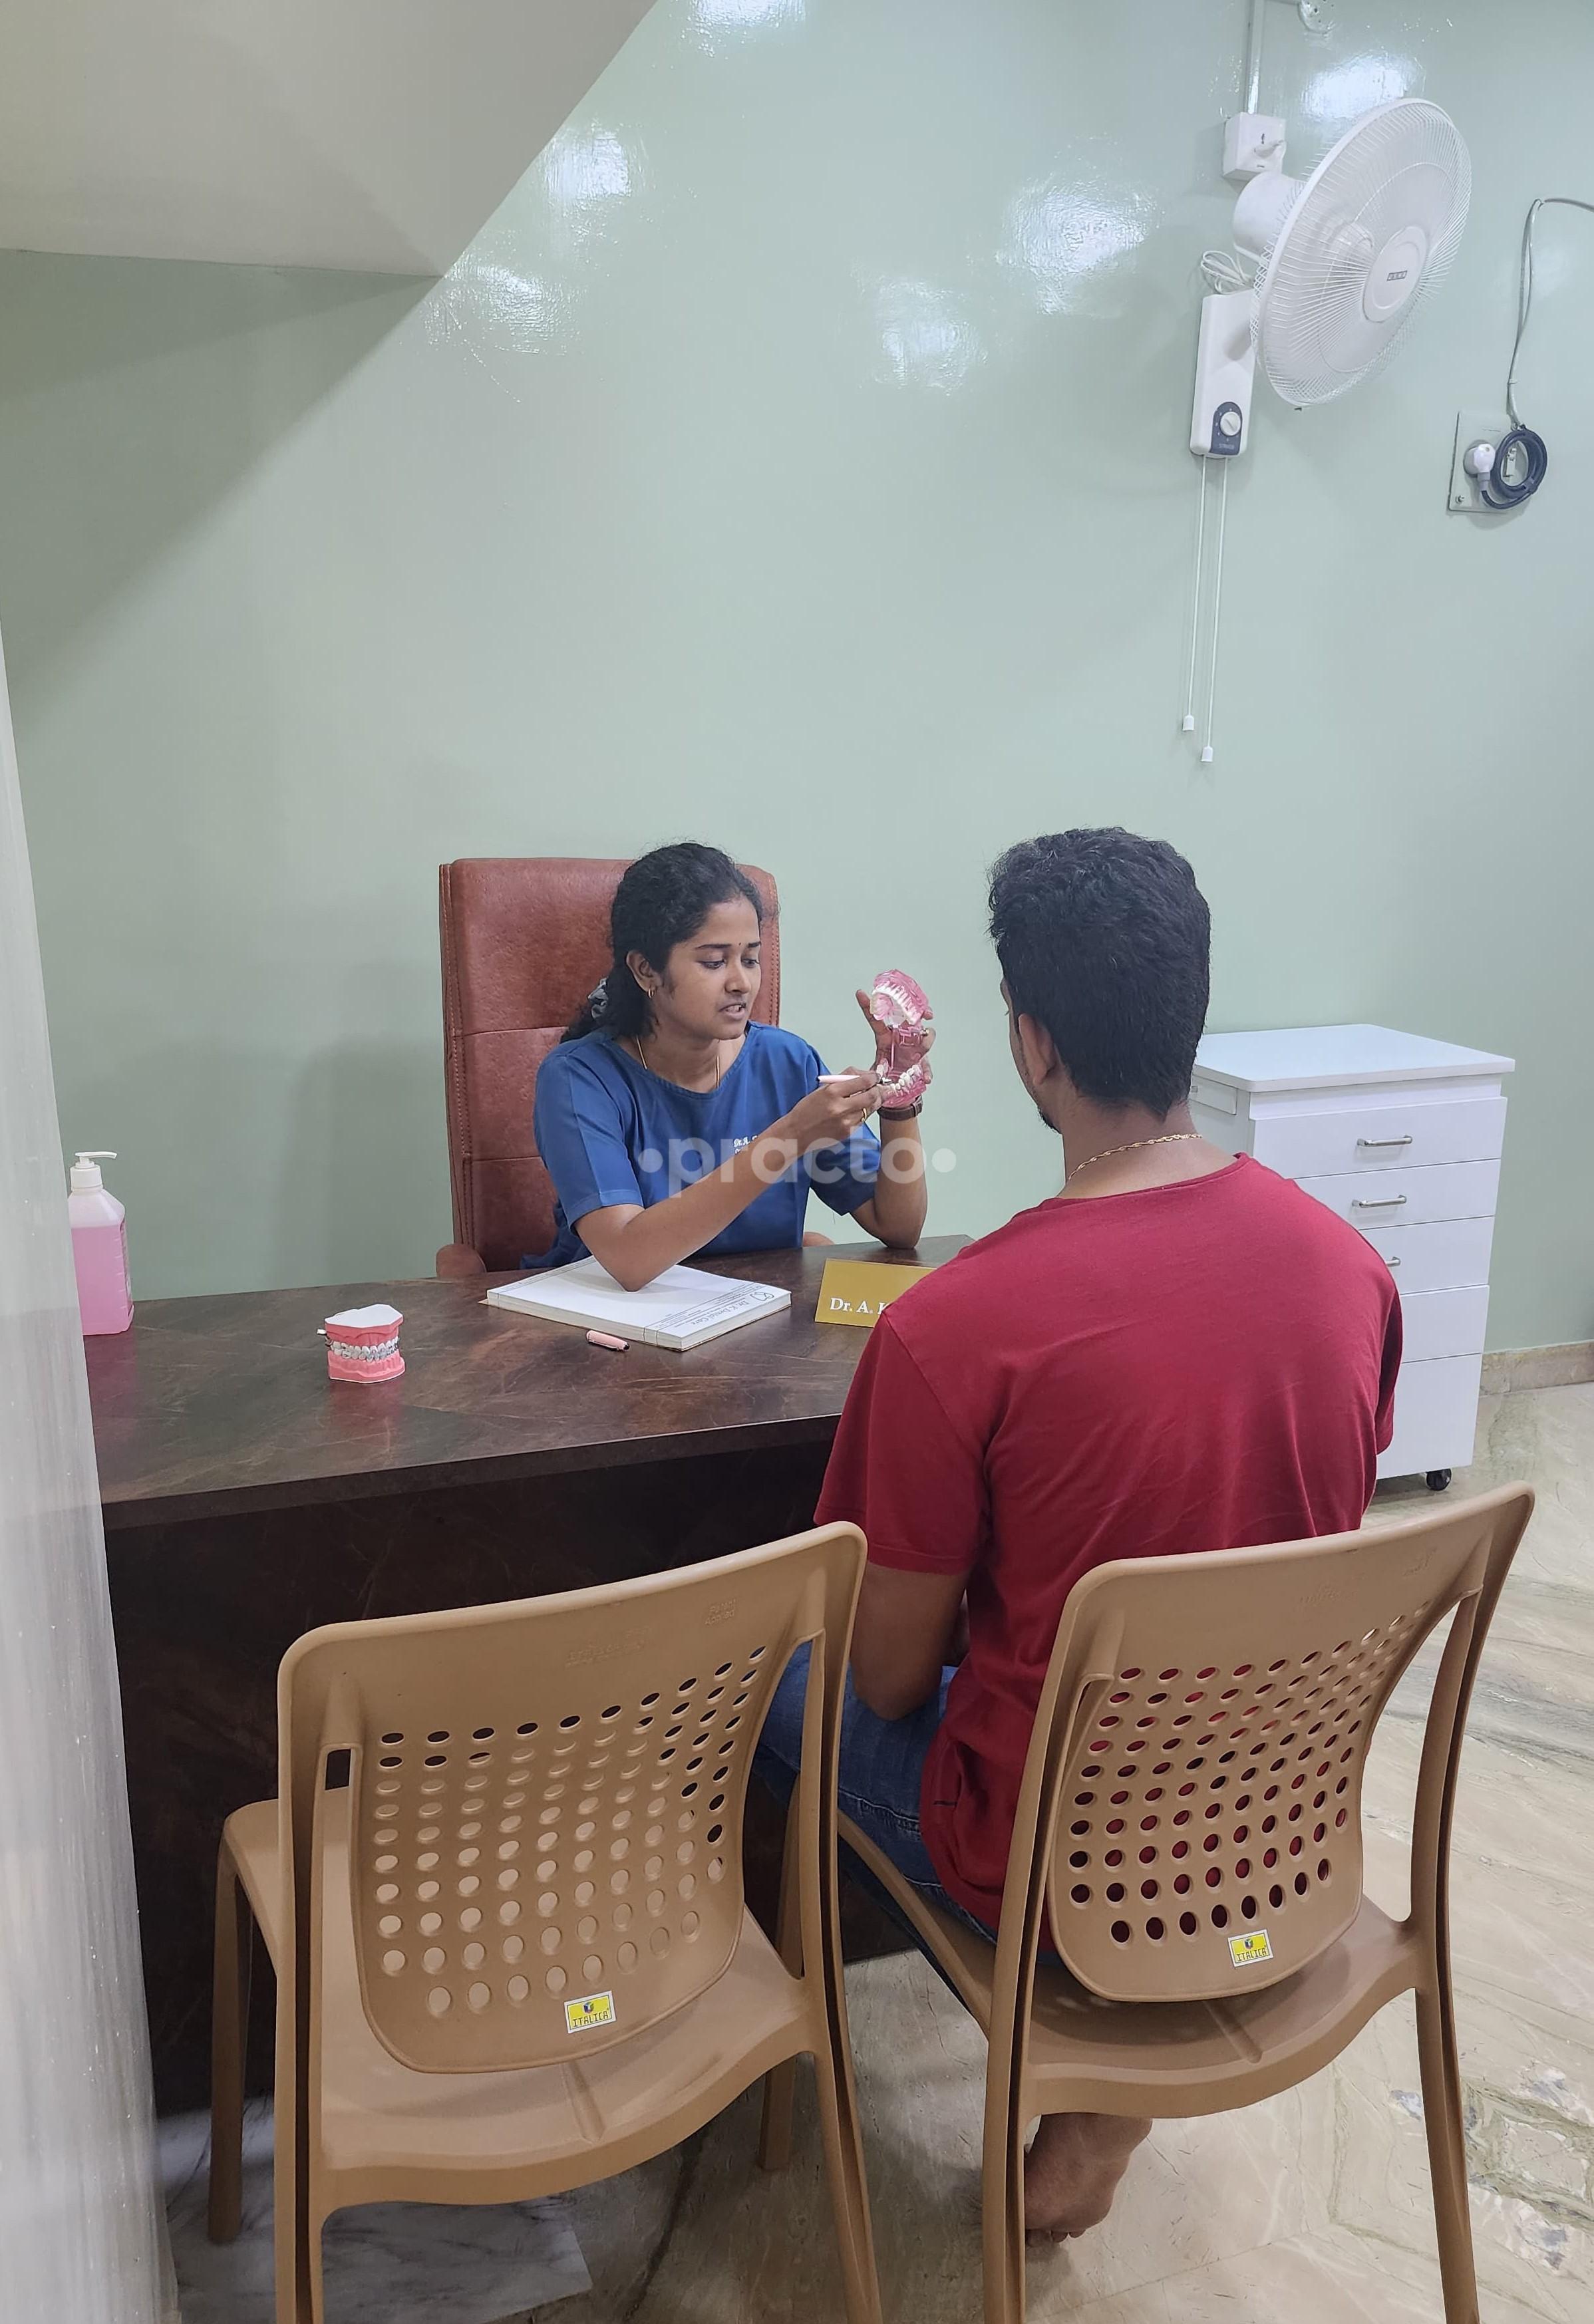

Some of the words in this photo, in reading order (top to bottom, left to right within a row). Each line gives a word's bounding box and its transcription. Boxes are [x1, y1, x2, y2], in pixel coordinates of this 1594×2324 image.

[830, 1297, 853, 1312] Dr.
[856, 1300, 874, 1314] A.
[1237, 1948, 1267, 1961] ITALICA
[573, 2011, 609, 2027] ITALICA
